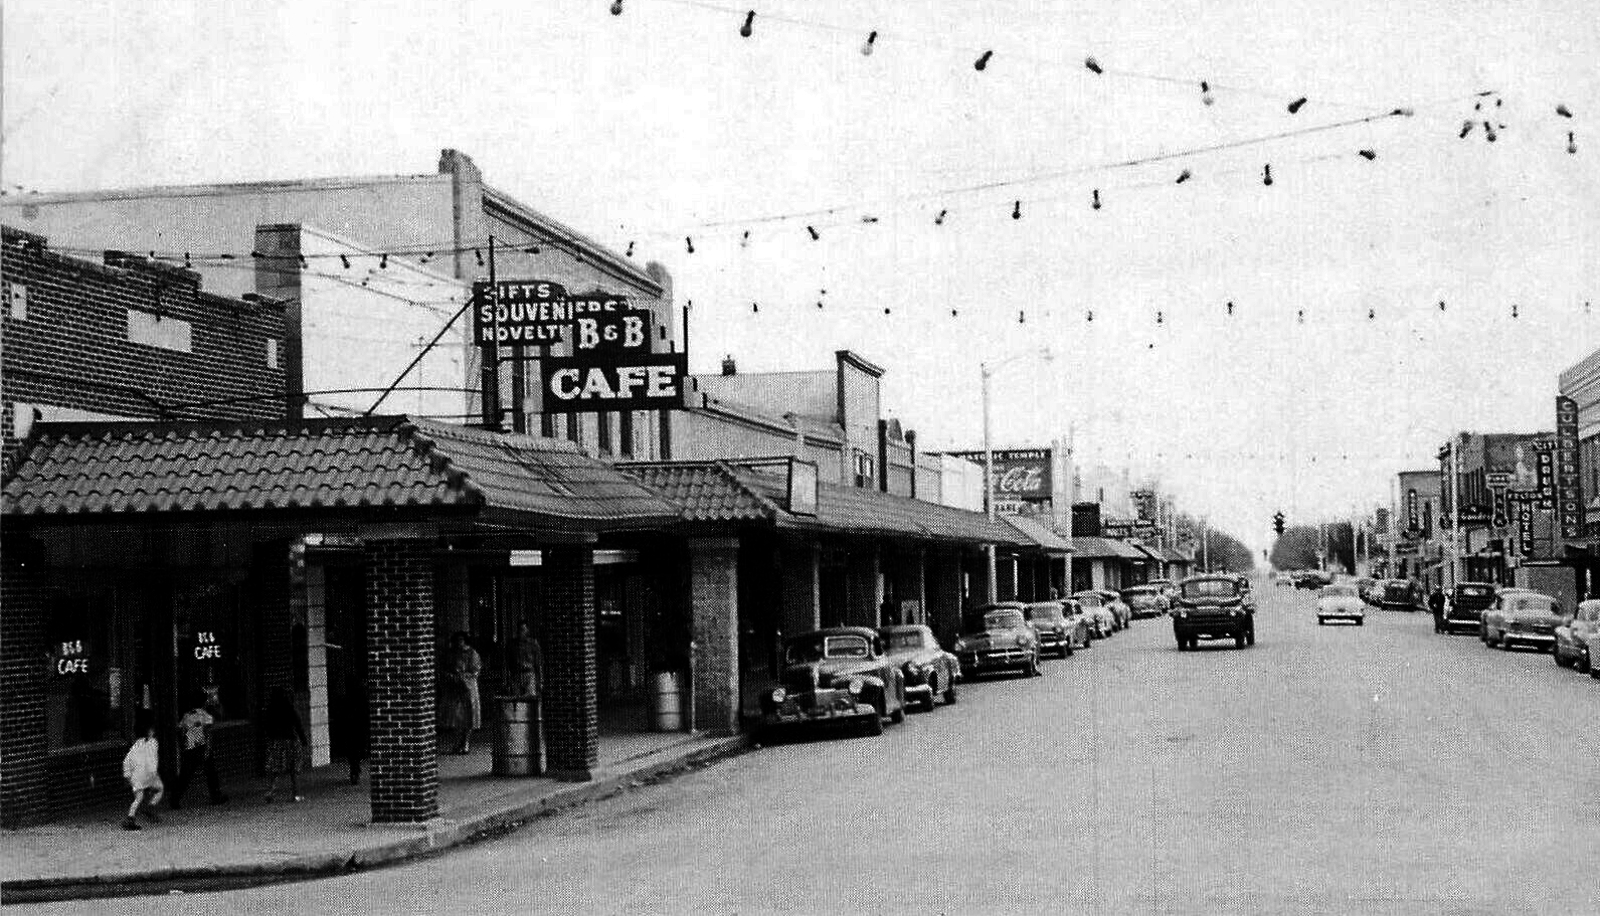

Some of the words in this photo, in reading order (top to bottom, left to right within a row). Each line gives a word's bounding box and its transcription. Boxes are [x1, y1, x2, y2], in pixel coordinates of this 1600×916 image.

[551, 365, 676, 400] CAFE
[959, 453, 1003, 461] ASOIC
[194, 645, 221, 660] CAFE
[57, 658, 88, 675] CAFE
